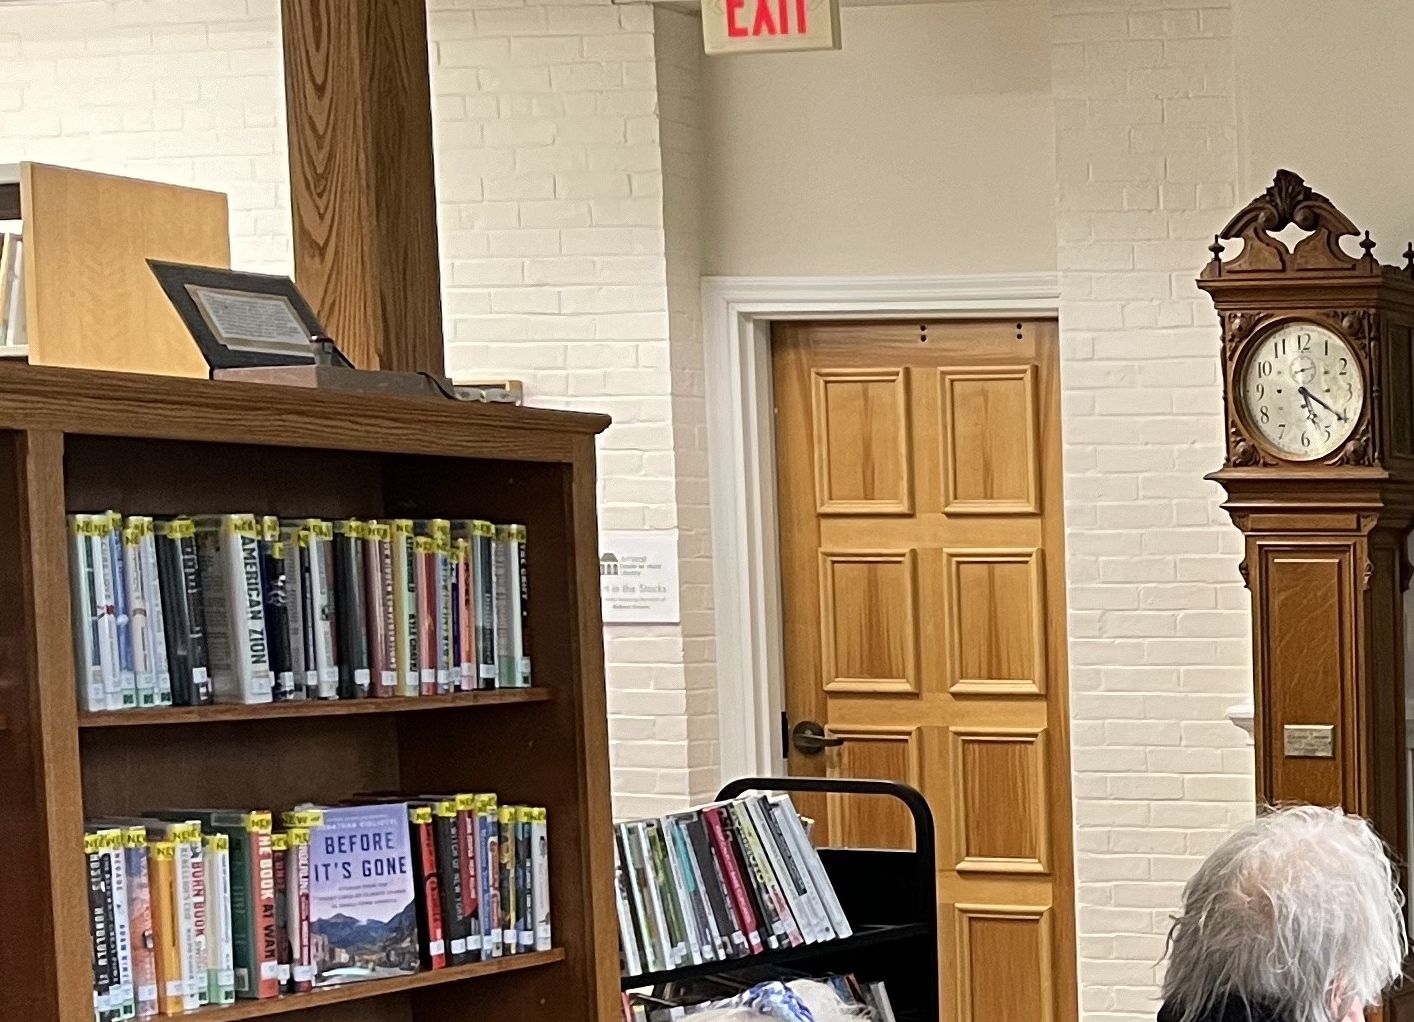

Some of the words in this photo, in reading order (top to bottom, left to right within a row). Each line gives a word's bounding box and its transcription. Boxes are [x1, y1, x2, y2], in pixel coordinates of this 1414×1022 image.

[1274, 338, 1286, 358] 11
[1298, 333, 1311, 350] 12
[1324, 340, 1329, 355] 1
[1258, 361, 1272, 378] 10
[1338, 358, 1348, 375] 2
[1256, 383, 1264, 401] 9
[1260, 406, 1269, 424] 8
[1278, 424, 1286, 440] 7
[1301, 431, 1310, 447] 6
[241, 536, 262, 621] AMERICAN
[249, 629, 267, 665] ZION
[325, 832, 395, 854] BEFORE
[314, 862, 351, 882] IT'S
[362, 856, 407, 877] GONE
[260, 859, 274, 900] BOOK
